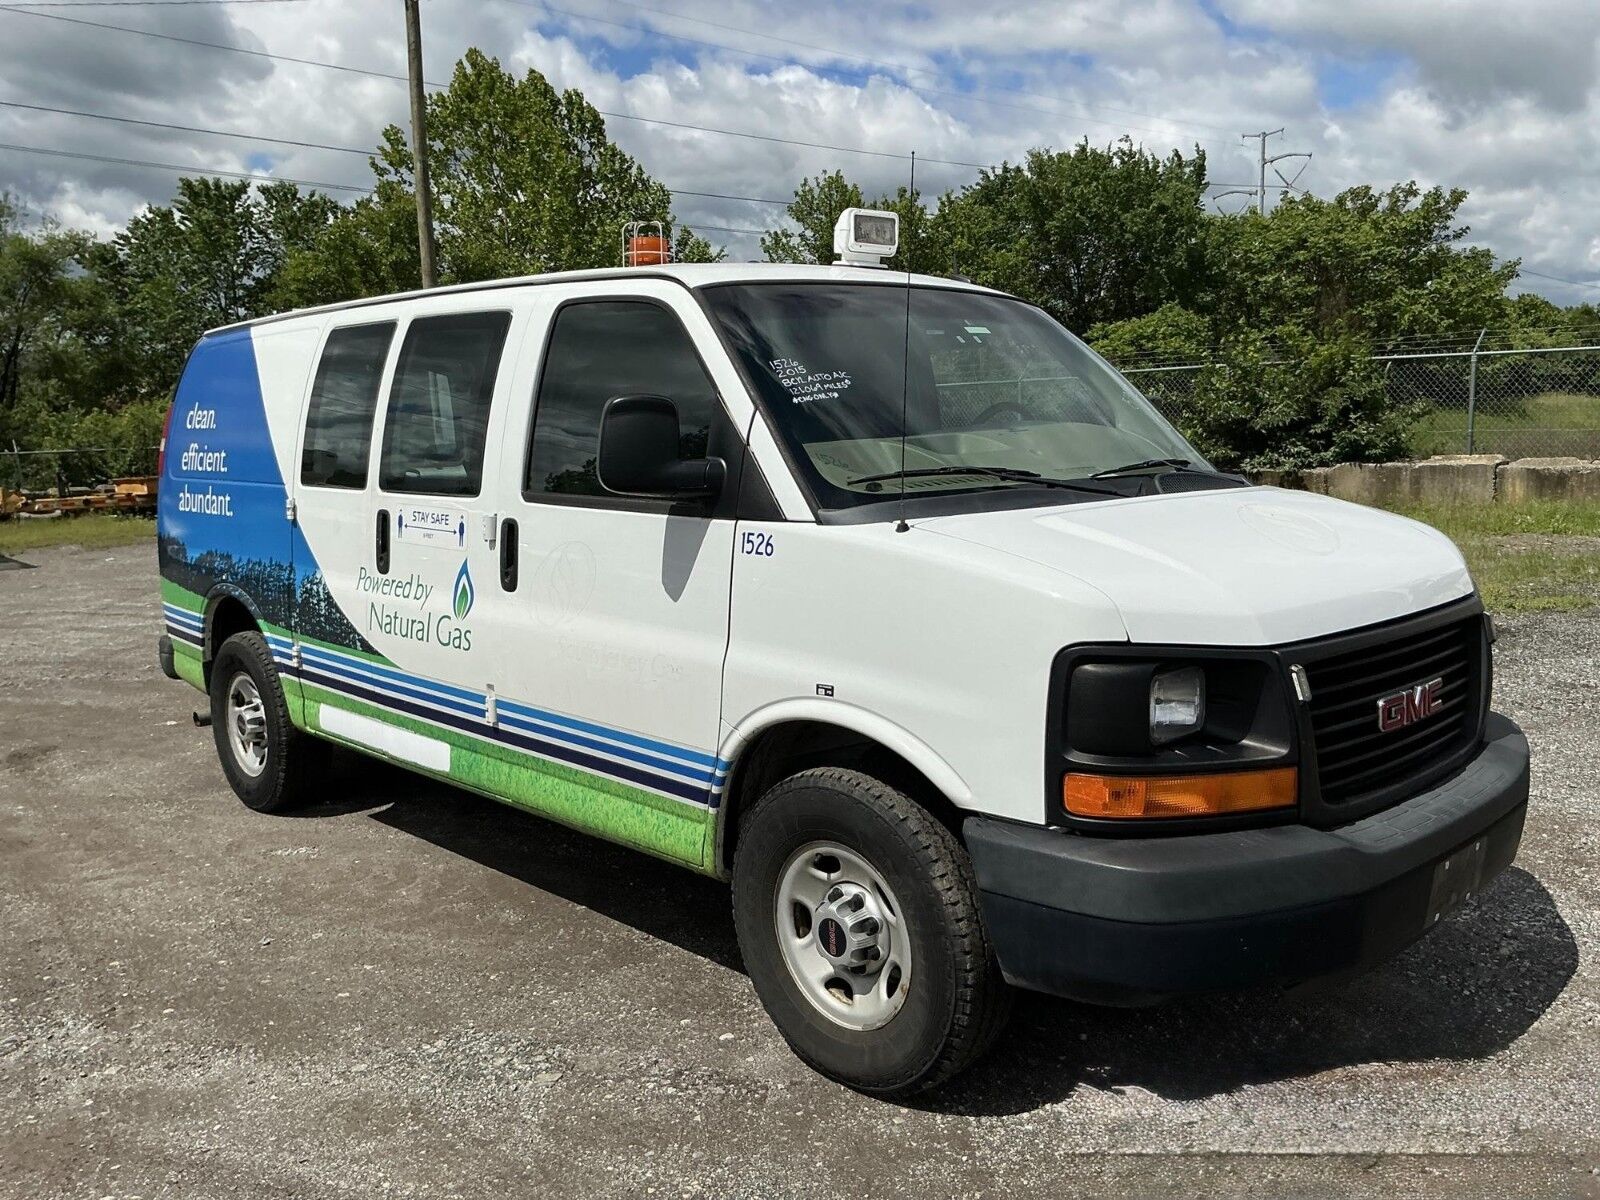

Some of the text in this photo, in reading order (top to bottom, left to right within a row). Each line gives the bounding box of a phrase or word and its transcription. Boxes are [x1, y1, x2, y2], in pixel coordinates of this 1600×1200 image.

[769, 358, 798, 370] 1526
[776, 365, 806, 378] 2015
[186, 402, 216, 429] clean.
[181, 443, 228, 472] efficient.
[178, 484, 233, 517] abundant.
[412, 511, 449, 525] STAY SAFE
[741, 531, 774, 557] 1526
[356, 566, 433, 611] Powered by
[369, 602, 472, 651] Natural Gas
[1377, 677, 1443, 732] GMC
[828, 920, 837, 955] GMC
